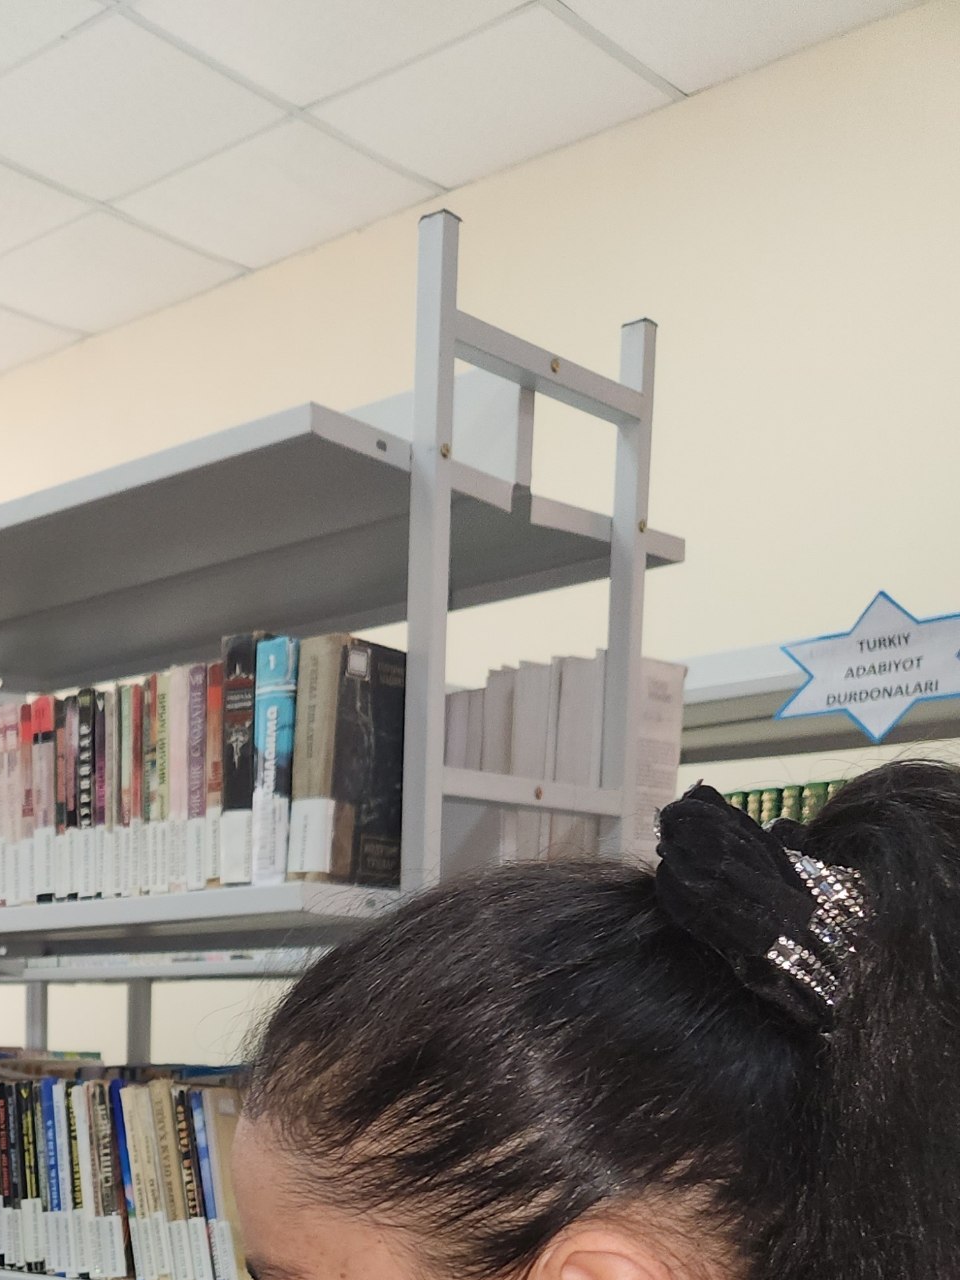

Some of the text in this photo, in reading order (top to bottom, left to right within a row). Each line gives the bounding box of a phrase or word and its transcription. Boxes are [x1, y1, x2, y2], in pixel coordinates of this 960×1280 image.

[857, 632, 911, 653] TURKIY
[843, 655, 924, 679] ADABIYOT
[826, 679, 939, 706] DURDONALARI
